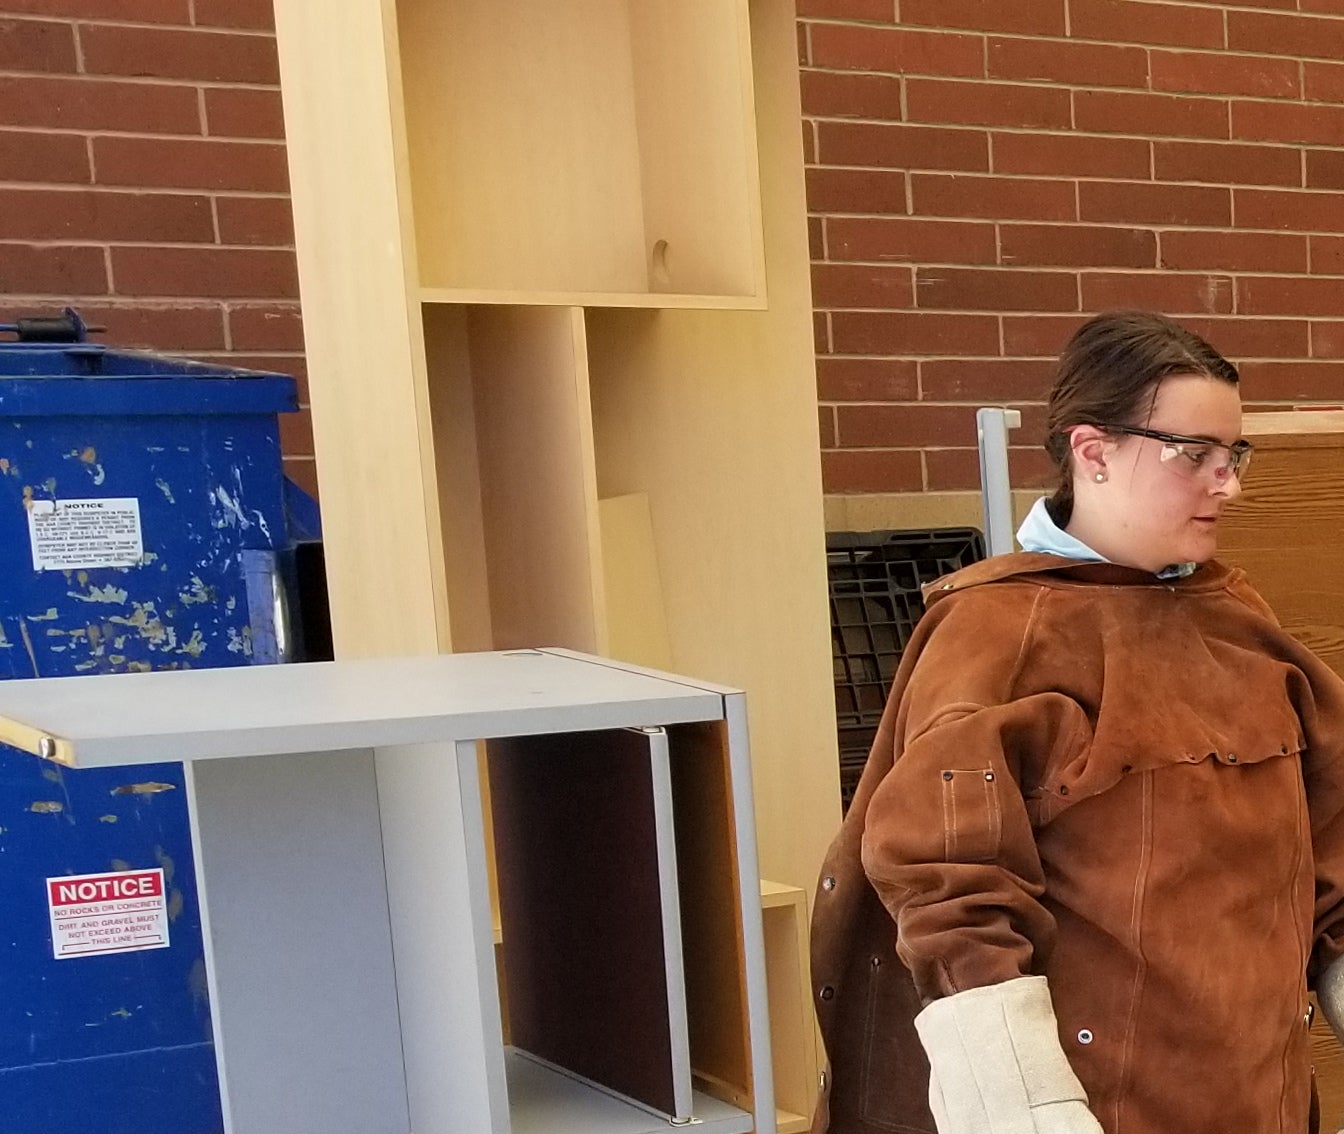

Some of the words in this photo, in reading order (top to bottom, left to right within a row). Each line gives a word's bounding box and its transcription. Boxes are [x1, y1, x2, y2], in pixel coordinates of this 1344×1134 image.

[59, 877, 155, 902] NOTICE
[54, 908, 68, 917] NO
[69, 906, 100, 915] ROCKS
[101, 904, 114, 912] OR
[116, 900, 161, 910] CONCRETE
[58, 923, 77, 931] DIRT
[81, 921, 99, 929] AND
[101, 918, 134, 927] GRAVEL
[136, 914, 160, 922] MUST
[88, 927, 121, 937] EXCEED
[124, 924, 152, 933] ABOVE
[91, 937, 111, 945] THIS
[113, 935, 133, 943] LINE
